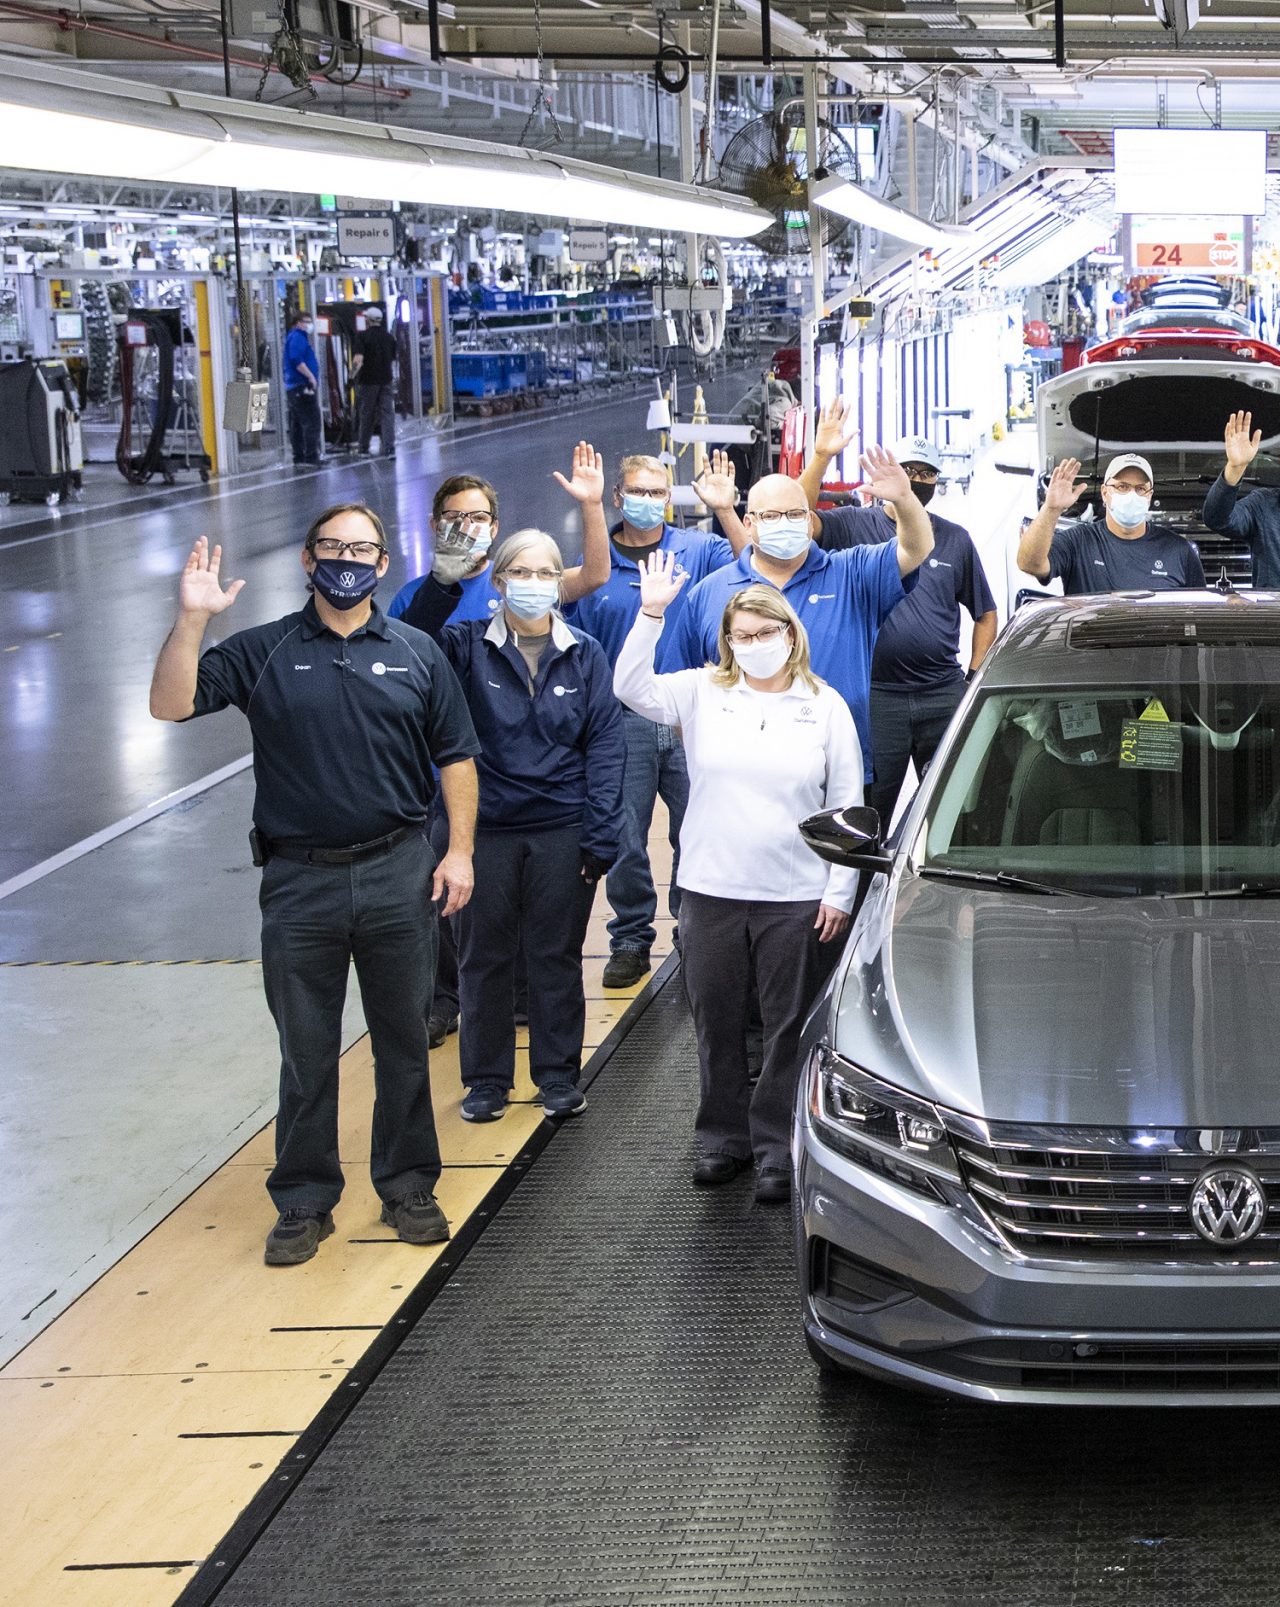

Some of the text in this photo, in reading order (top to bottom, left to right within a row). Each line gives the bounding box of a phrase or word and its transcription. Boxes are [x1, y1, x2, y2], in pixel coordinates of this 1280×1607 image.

[345, 228, 390, 239] Repair 6
[573, 241, 598, 249] Repair
[1151, 244, 1183, 266] 24
[1191, 1169, 1265, 1245] VW
